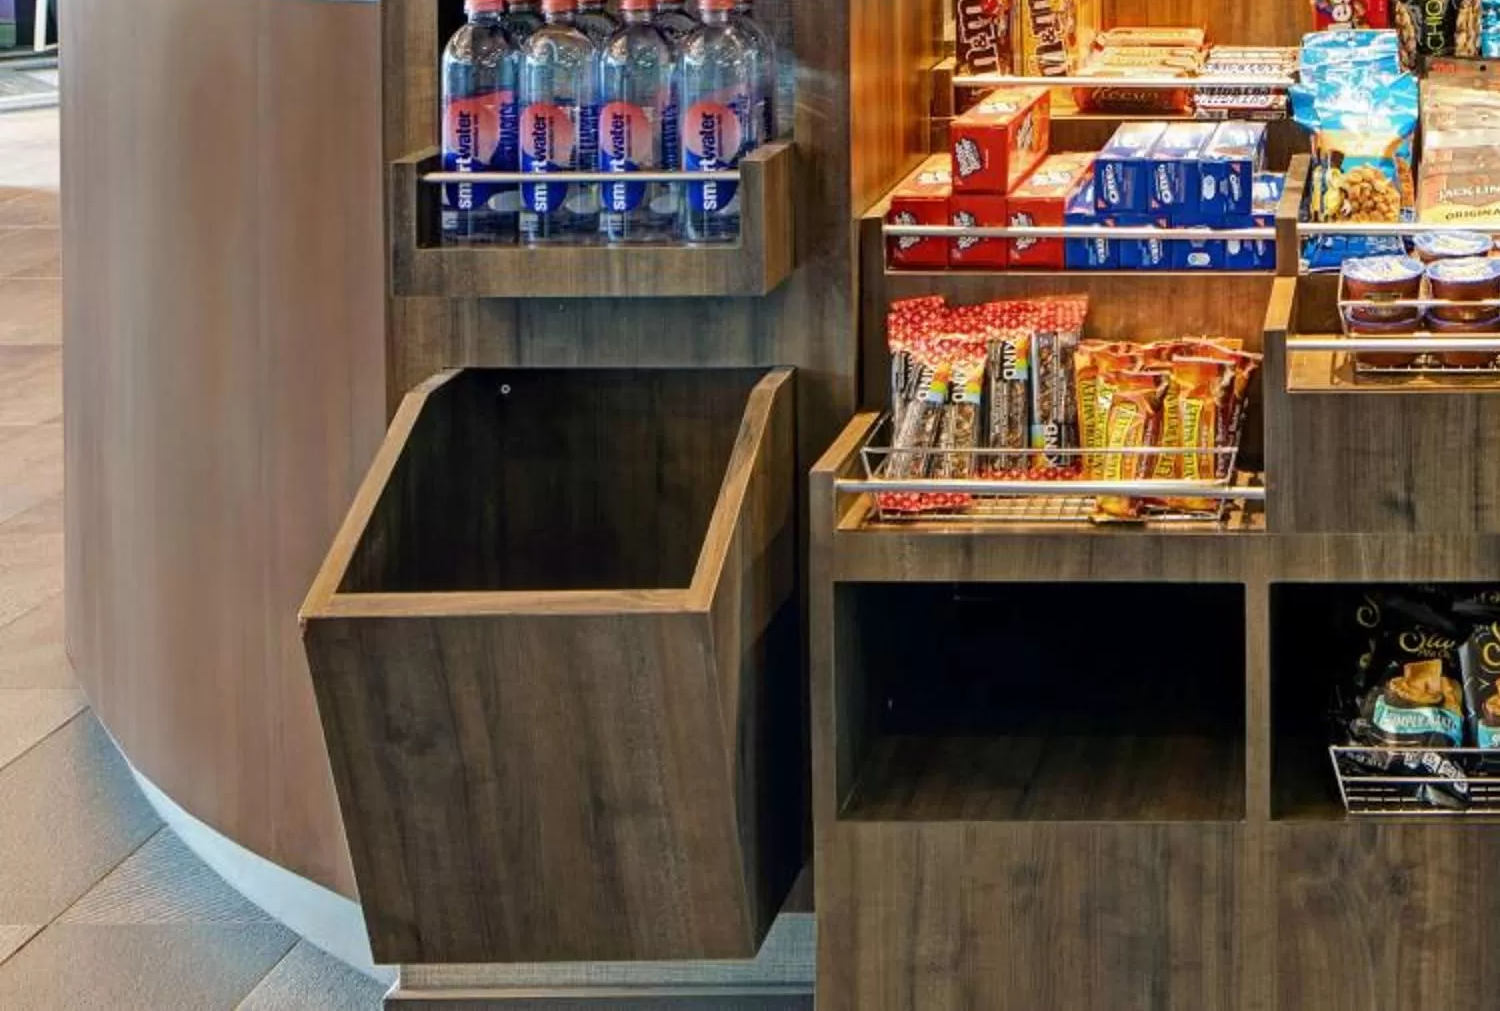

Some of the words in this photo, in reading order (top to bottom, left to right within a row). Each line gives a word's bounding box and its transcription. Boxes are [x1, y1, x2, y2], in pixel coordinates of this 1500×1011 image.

[455, 109, 472, 209] smrtwater
[530, 112, 548, 211] smrtwater
[609, 112, 625, 211] smrtwater
[698, 112, 718, 211] smrtwater
